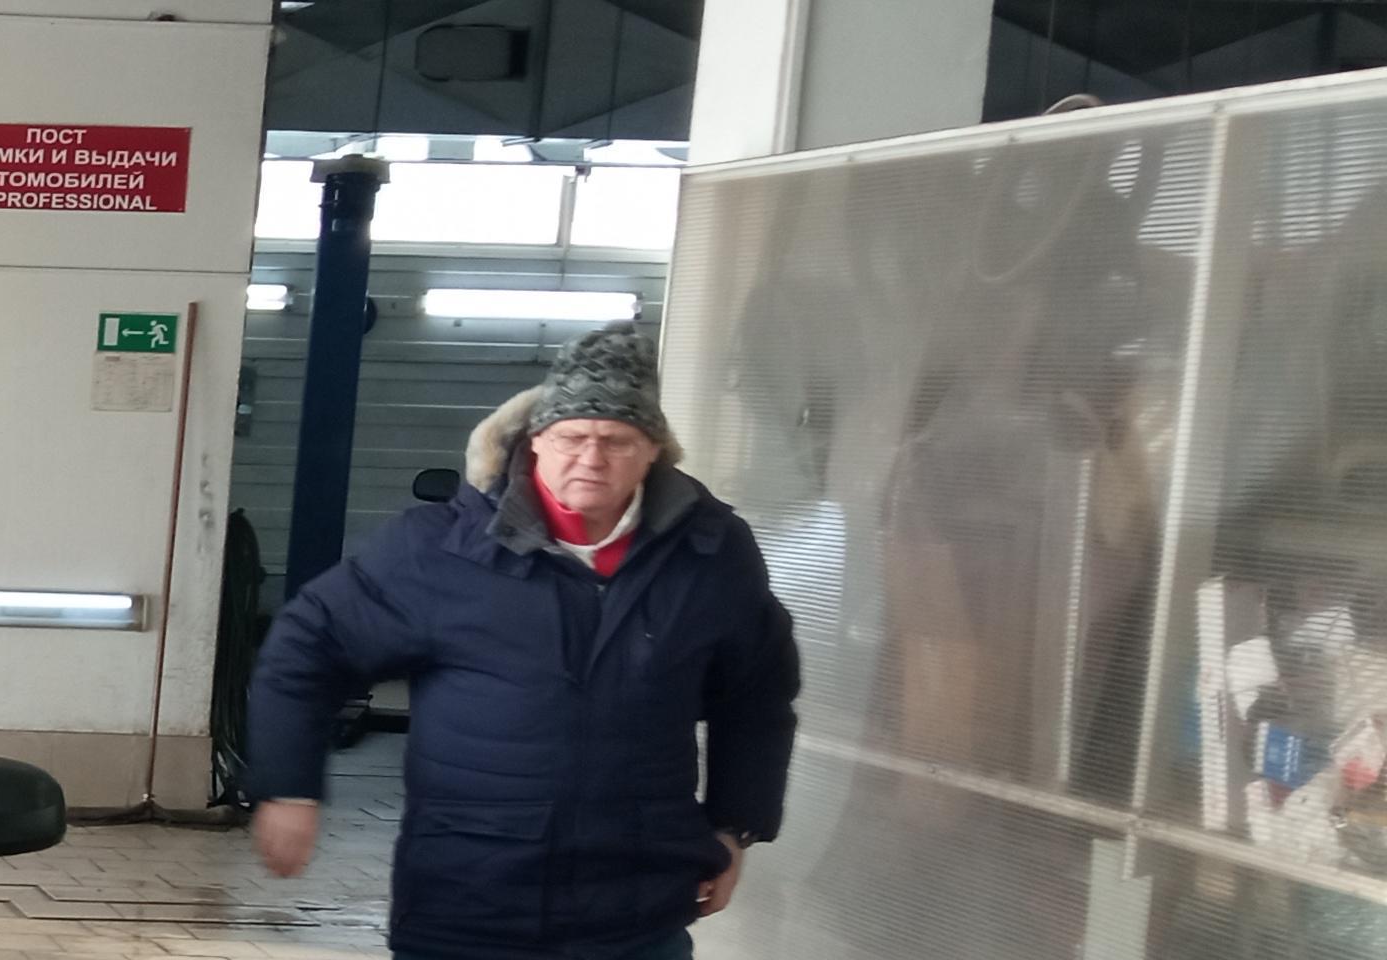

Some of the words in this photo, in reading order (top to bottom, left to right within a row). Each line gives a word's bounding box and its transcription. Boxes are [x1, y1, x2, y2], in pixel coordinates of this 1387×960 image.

[26, 128, 87, 144] ПОСТ
[51, 148, 67, 164] И
[74, 149, 177, 168] ВЫДАЧИ
